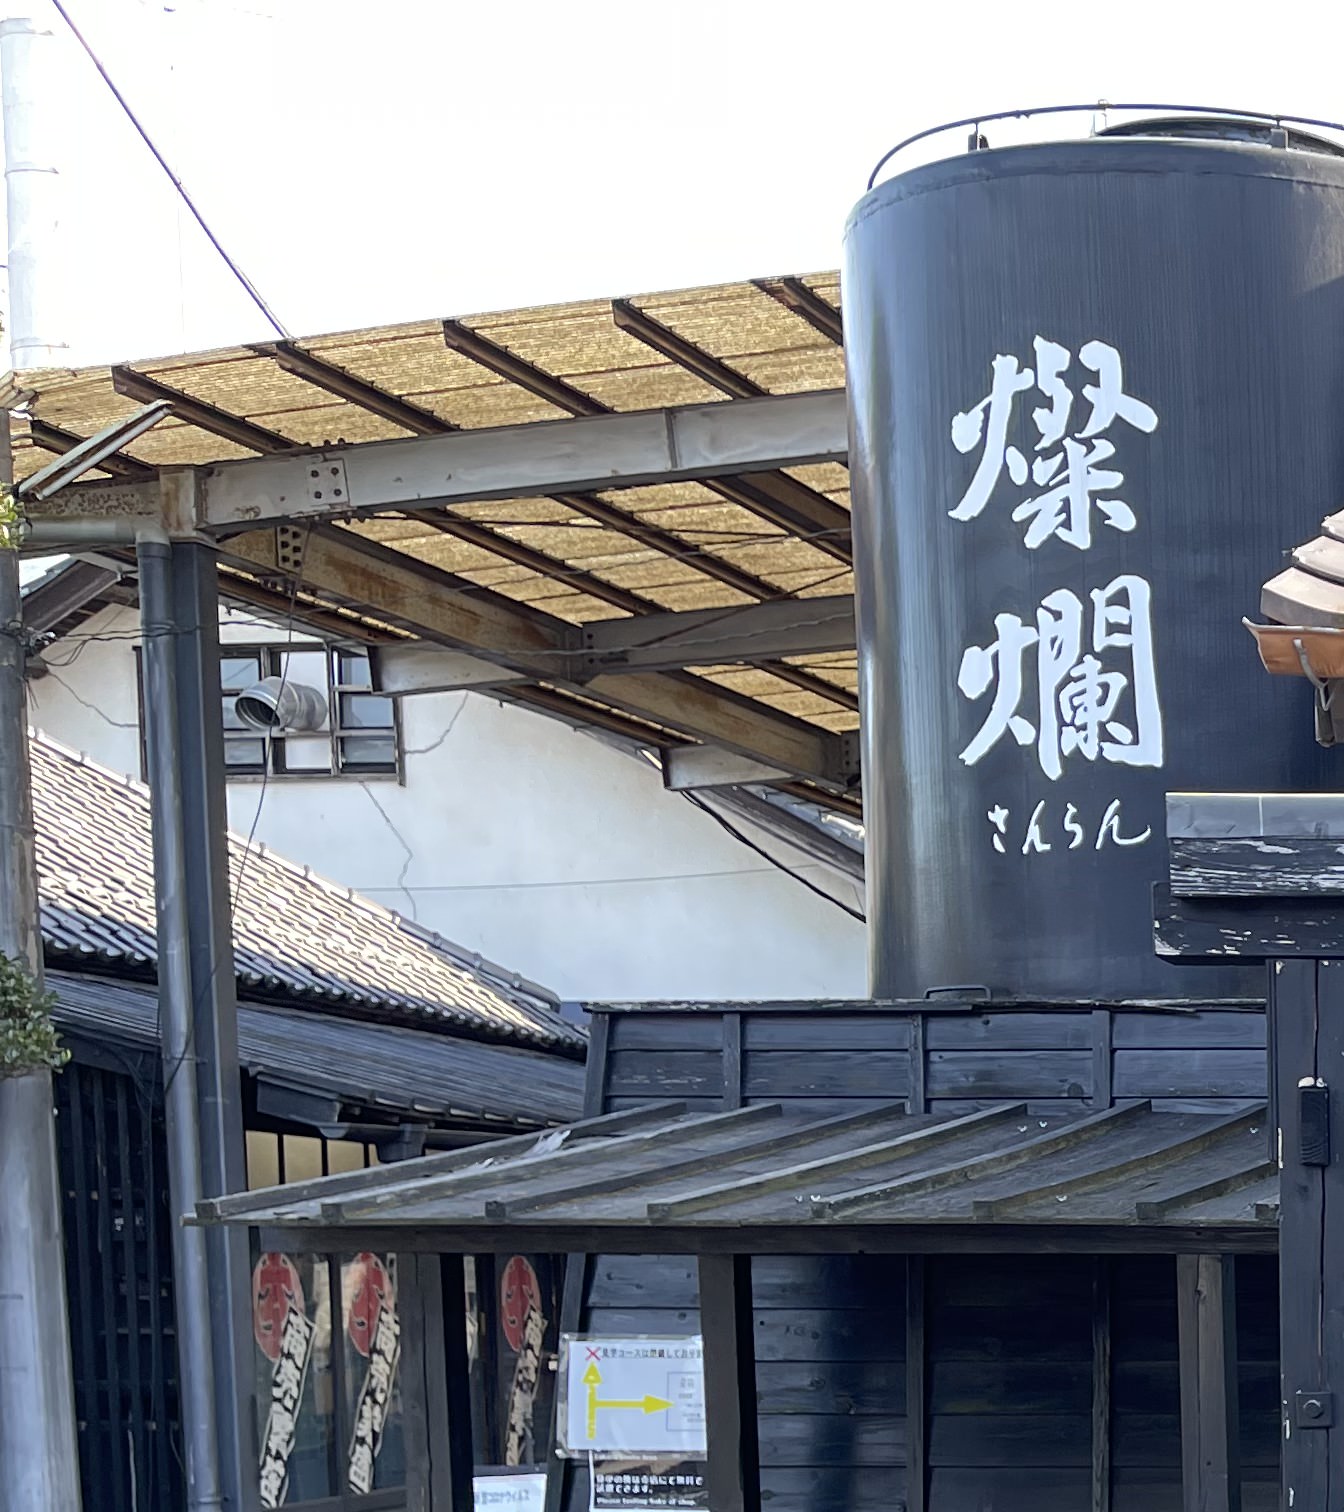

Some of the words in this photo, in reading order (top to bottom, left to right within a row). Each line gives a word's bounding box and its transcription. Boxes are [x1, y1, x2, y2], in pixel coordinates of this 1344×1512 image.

[947, 335, 1163, 780] 燦爛
[987, 798, 1151, 854] さんらん
